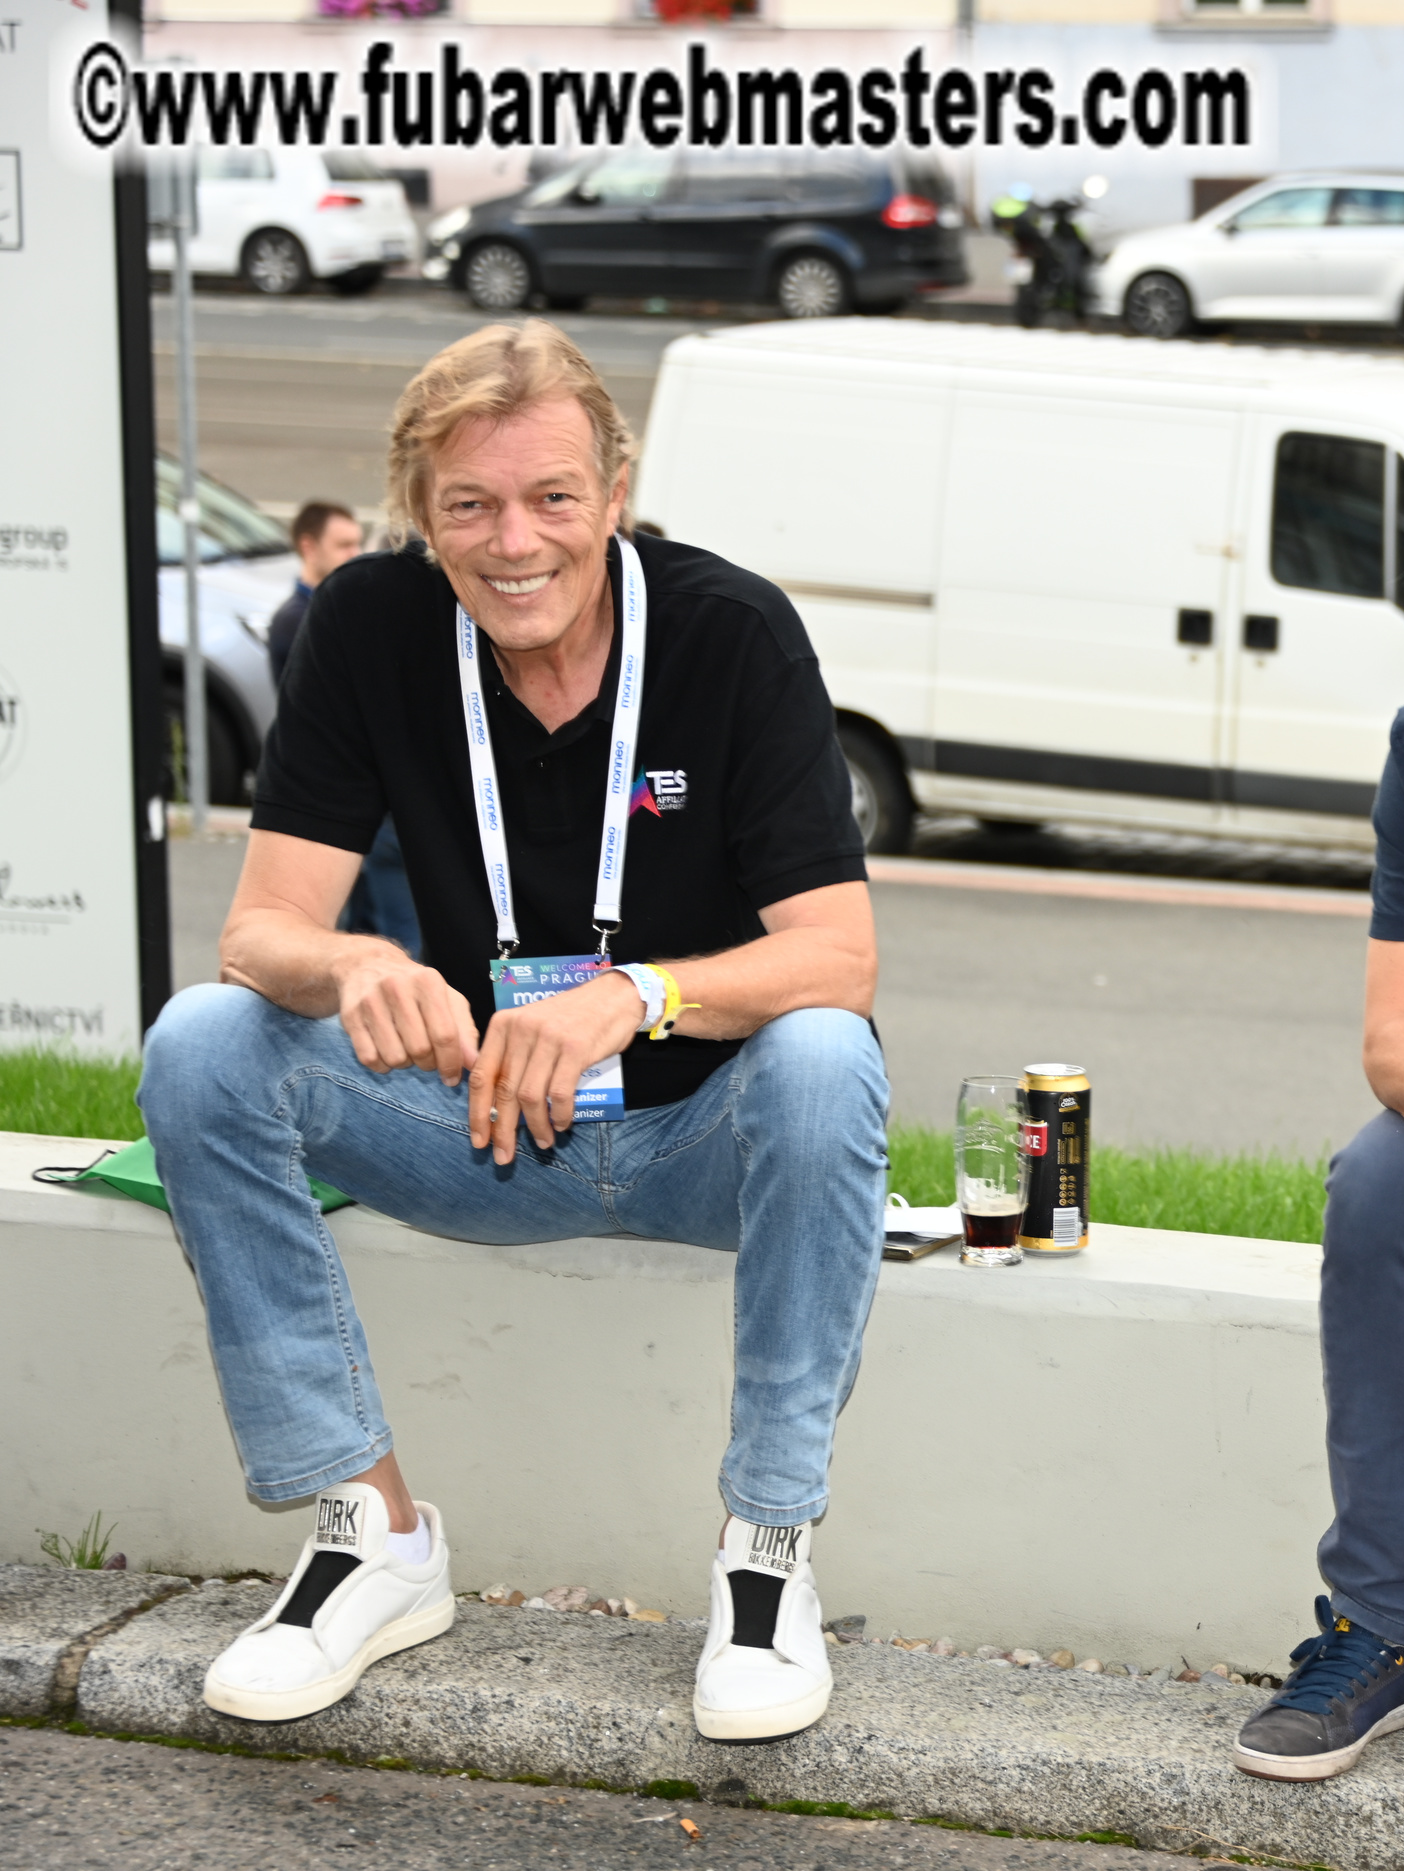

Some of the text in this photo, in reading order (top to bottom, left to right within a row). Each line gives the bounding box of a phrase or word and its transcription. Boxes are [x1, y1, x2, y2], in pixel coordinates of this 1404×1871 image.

[621, 654, 634, 708] monneo
[471, 691, 486, 745] monneo
[612, 740, 625, 794] monneo
[645, 769, 688, 796] TES
[483, 777, 498, 831] monneo
[603, 826, 616, 880] monneo
[494, 863, 509, 916] monneo
[510, 965, 533, 977] TES
[540, 963, 591, 973] WELCOME
[540, 971, 598, 985] PRAGU
[573, 1108, 605, 1120] anizer
[575, 1091, 608, 1103] anizer
[318, 1498, 359, 1534] DIRK
[751, 1526, 803, 1562] DIRK
